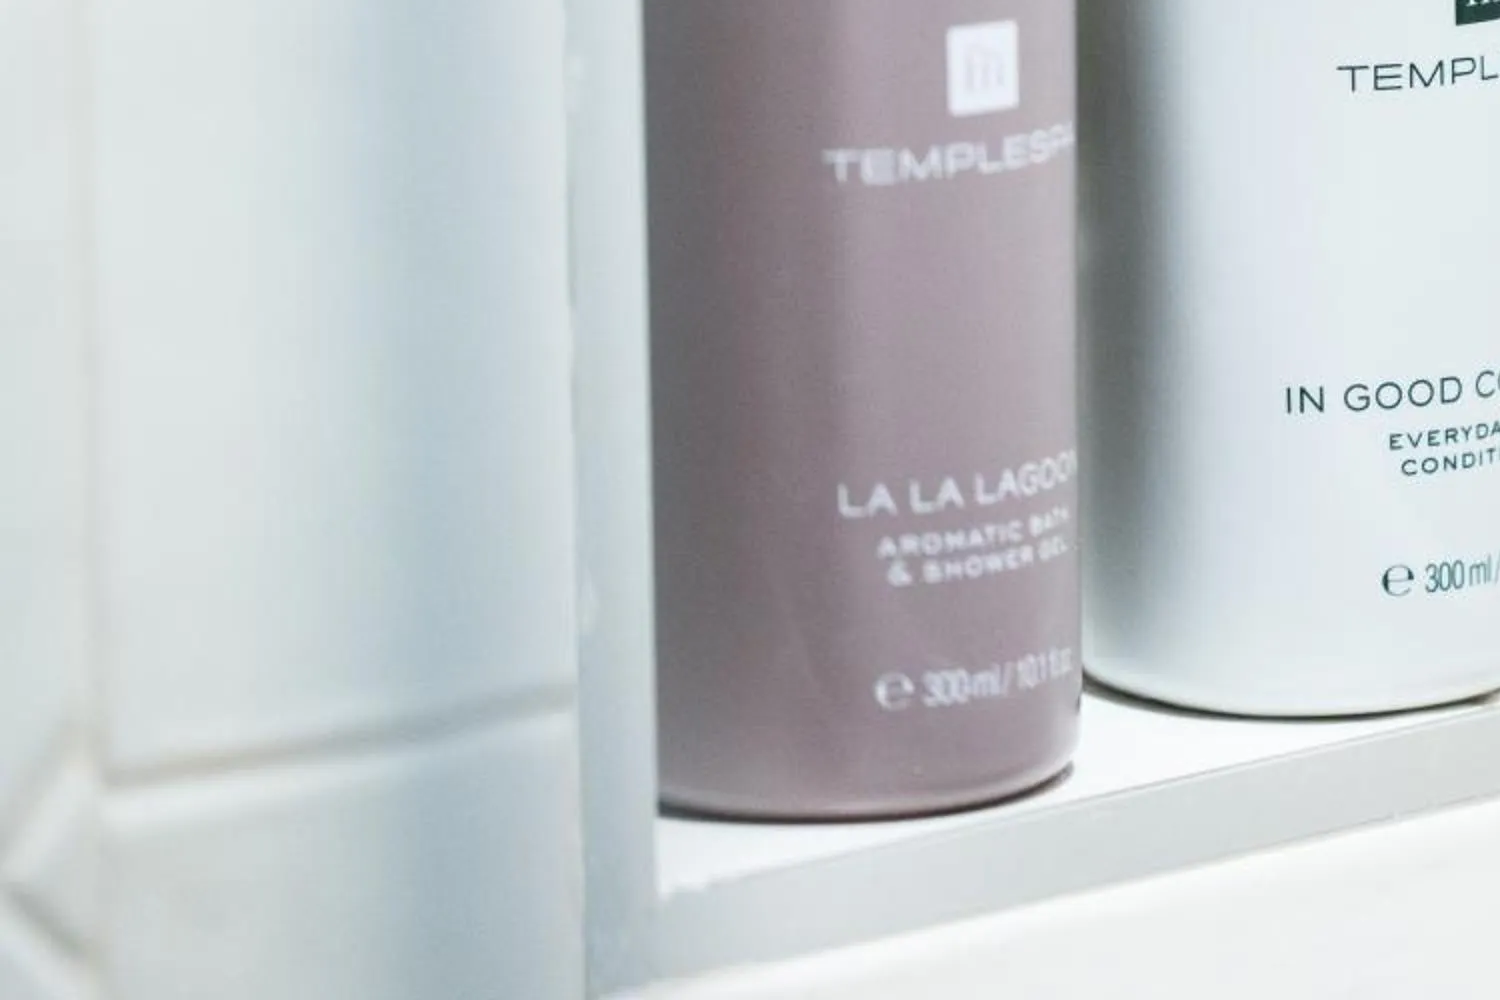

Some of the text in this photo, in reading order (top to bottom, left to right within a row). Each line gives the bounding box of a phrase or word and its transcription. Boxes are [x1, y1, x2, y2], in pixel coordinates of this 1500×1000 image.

[1285, 385, 1325, 414] IN
[1343, 376, 1463, 412] GOOD
[837, 482, 897, 518] LA
[910, 475, 964, 514] LA
